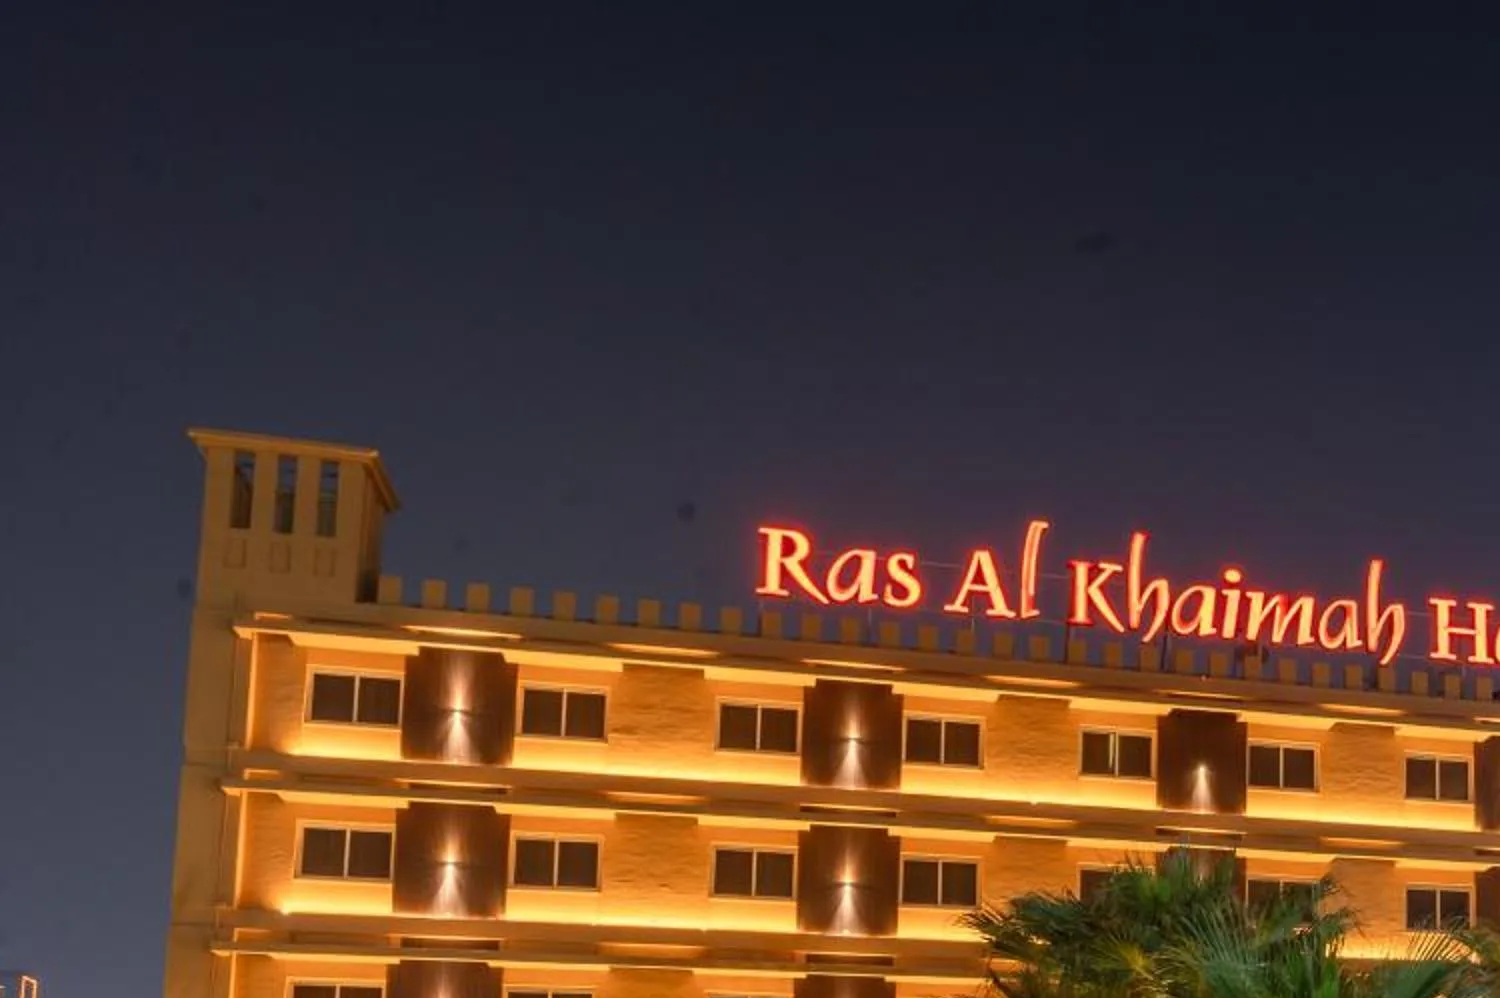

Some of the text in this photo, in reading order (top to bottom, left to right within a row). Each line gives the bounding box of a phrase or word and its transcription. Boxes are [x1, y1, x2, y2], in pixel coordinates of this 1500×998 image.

[754, 525, 923, 608] Ras
[942, 519, 1050, 620] Al
[1066, 530, 1407, 667] Khaimah
